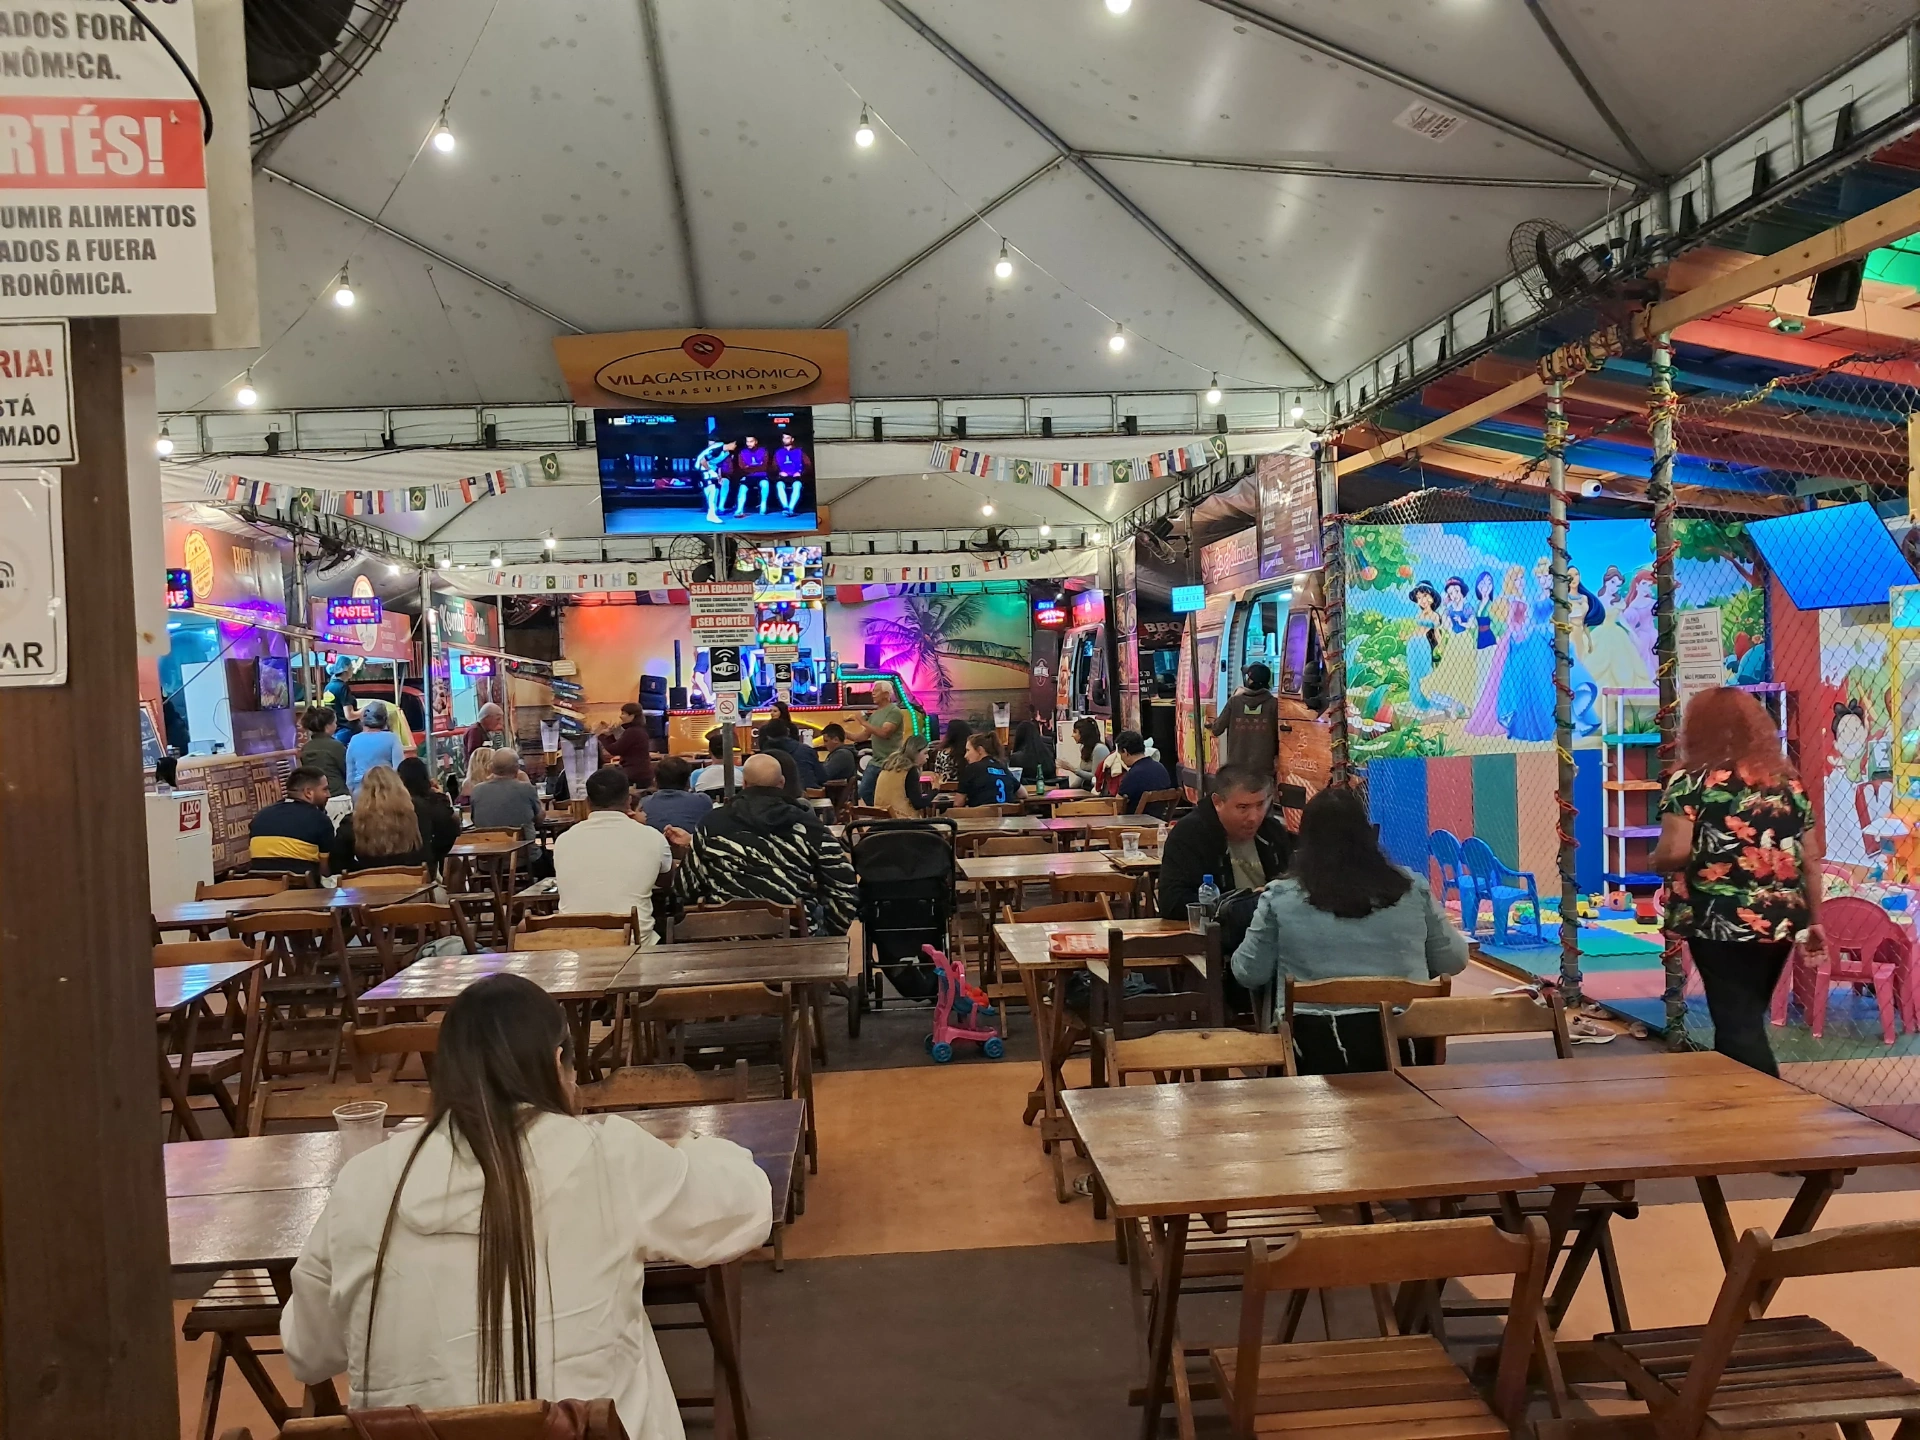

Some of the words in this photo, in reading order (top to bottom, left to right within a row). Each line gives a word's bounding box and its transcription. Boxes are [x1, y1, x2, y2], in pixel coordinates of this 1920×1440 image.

[76, 12, 147, 42] FORA
[69, 204, 197, 229] ALIMENTOS
[66, 239, 81, 262] A
[86, 237, 156, 262] FUERA
[643, 383, 778, 397] CANASVIEIRAS
[690, 585, 710, 594] SEJA
[711, 584, 752, 593] EDUCADO!
[335, 605, 374, 618] PASTEL
[715, 615, 750, 626] CORTÉS!
[760, 622, 798, 642] CAIXA
[995, 778, 1006, 804] 3
[181, 800, 201, 816] LIXO
